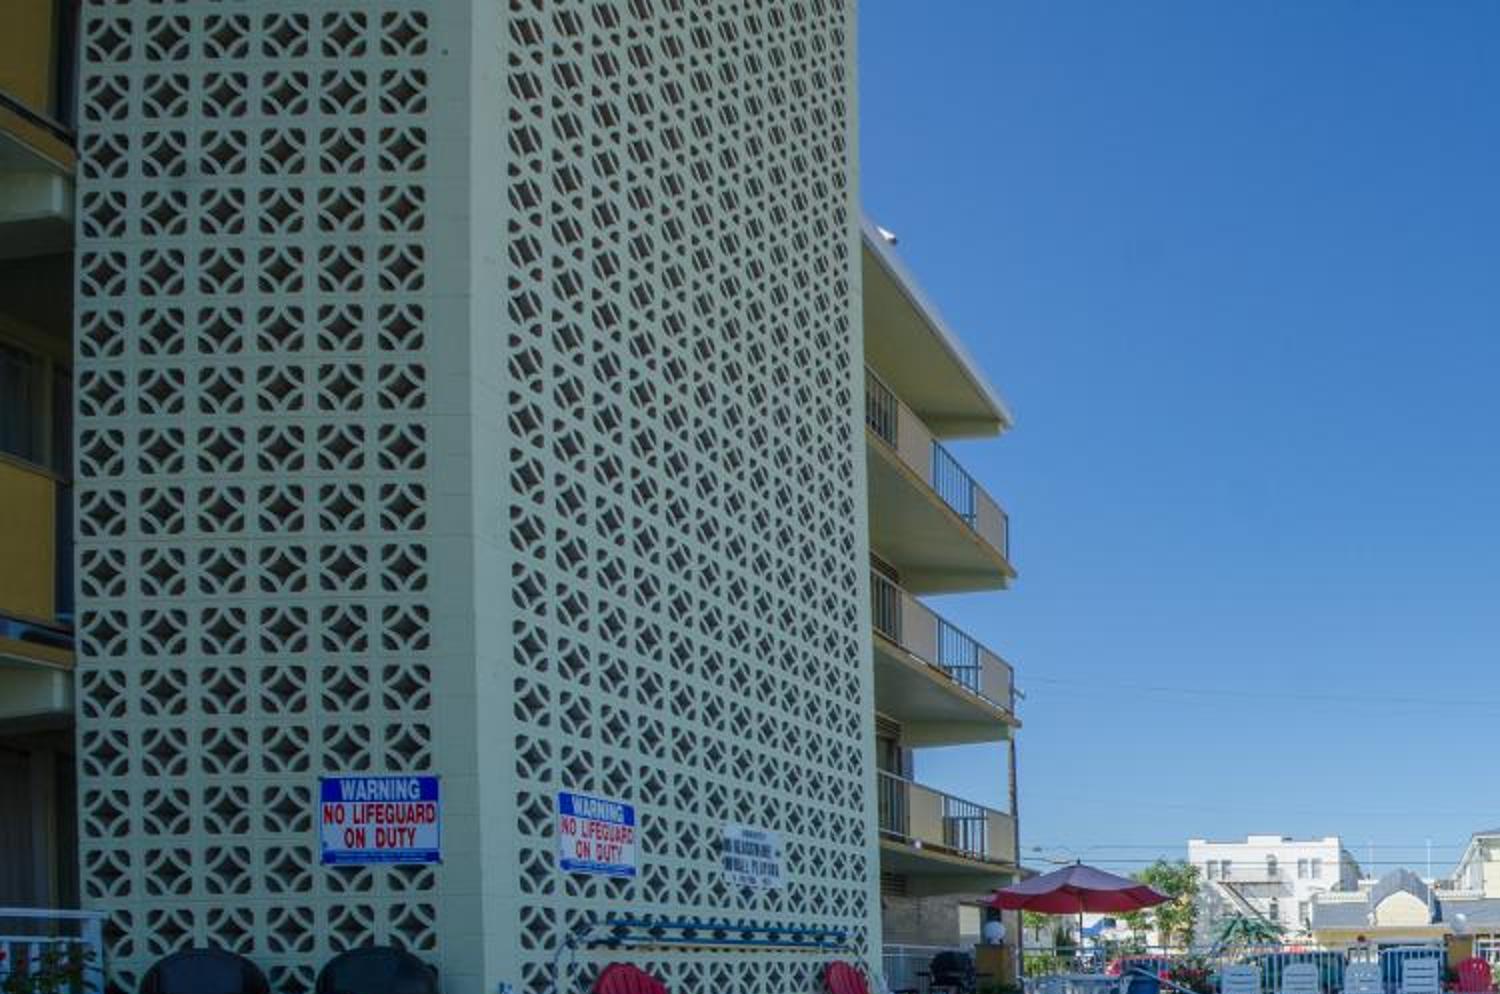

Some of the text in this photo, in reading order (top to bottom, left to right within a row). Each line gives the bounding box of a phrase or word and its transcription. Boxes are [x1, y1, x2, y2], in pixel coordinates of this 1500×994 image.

[340, 779, 421, 800] WARNING
[323, 803, 435, 824] NO LIFEGUARD
[571, 794, 624, 823] WARNING
[344, 827, 416, 848] ON DUTY
[561, 817, 633, 844] NO LIFEGUARD
[576, 840, 622, 863] ON DUTY
